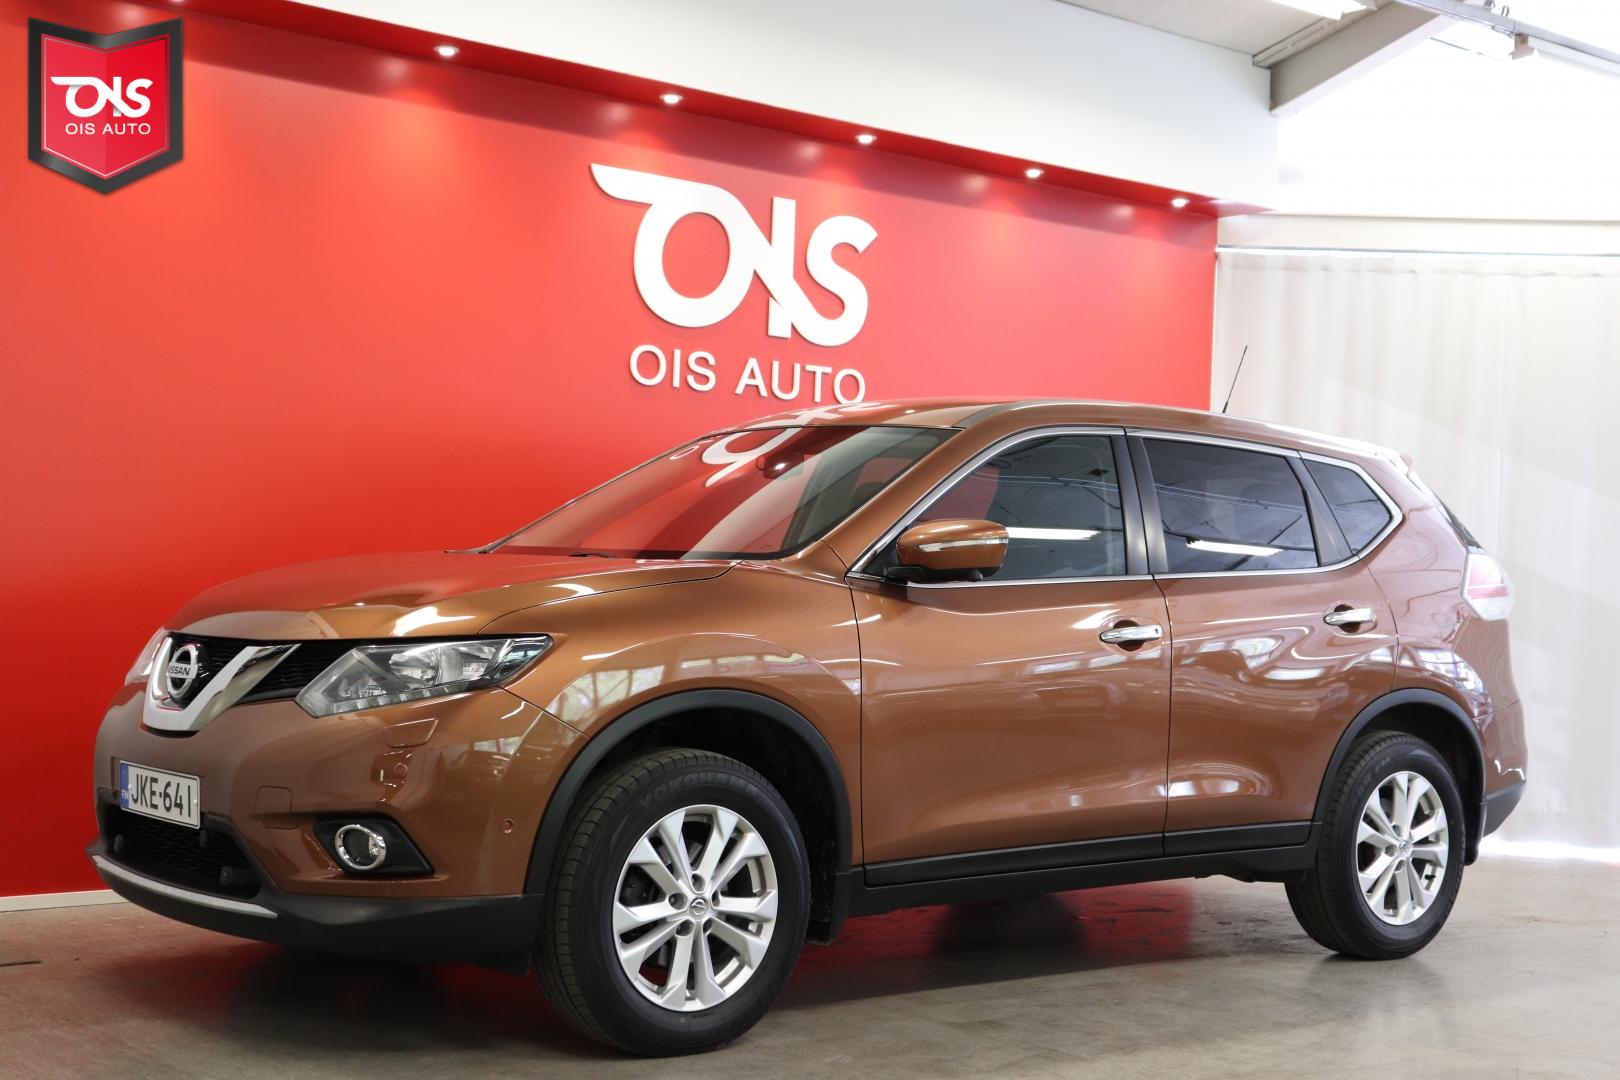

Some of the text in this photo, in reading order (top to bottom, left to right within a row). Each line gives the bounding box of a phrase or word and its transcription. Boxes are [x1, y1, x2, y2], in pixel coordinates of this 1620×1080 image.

[590, 162, 878, 347] OIS
[629, 344, 866, 405] OIS AUTO
[169, 665, 191, 675] ISSAN
[131, 773, 192, 818] JKE-641
